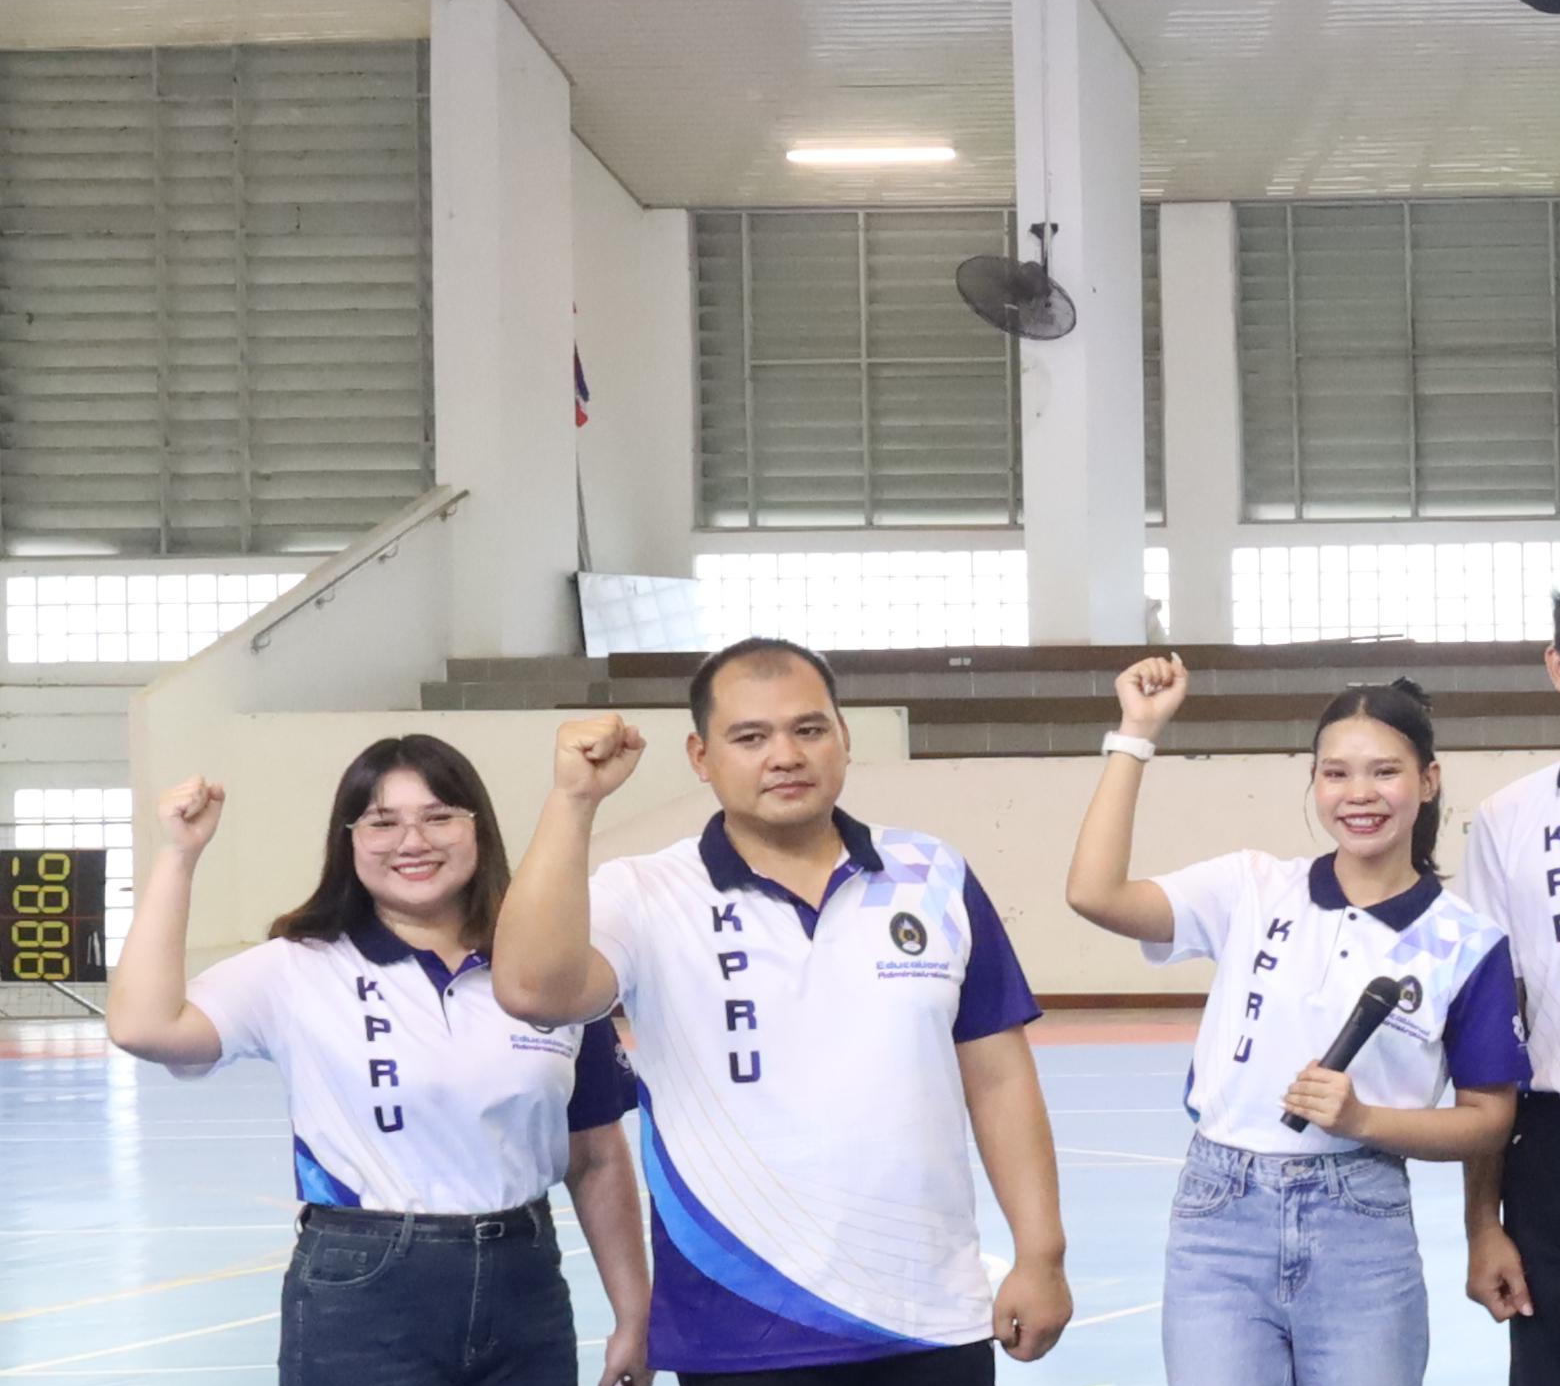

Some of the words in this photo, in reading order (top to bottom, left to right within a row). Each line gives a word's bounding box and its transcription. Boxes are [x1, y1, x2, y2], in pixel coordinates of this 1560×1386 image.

[356, 976, 405, 1133] KPRU
[712, 902, 760, 1084] KPRU
[1234, 917, 1293, 1063] KPRU
